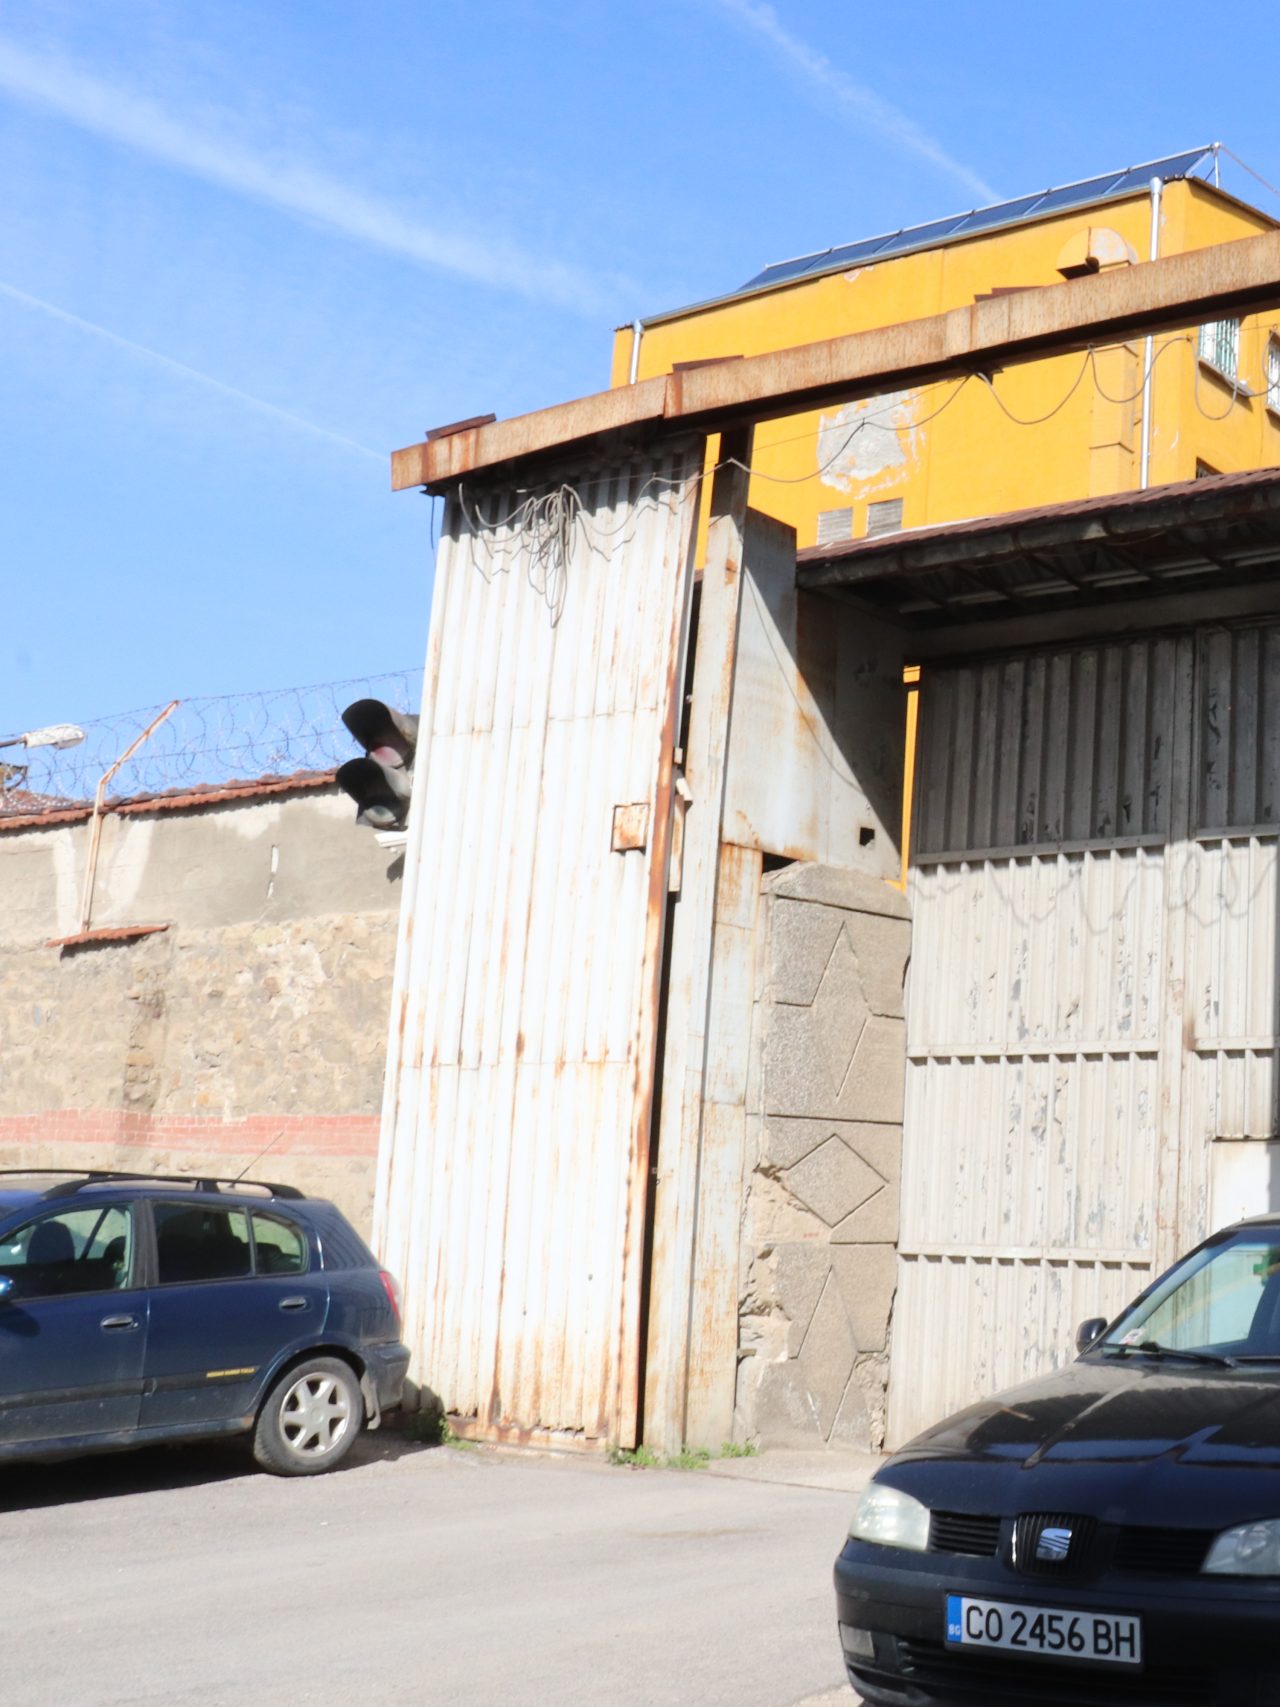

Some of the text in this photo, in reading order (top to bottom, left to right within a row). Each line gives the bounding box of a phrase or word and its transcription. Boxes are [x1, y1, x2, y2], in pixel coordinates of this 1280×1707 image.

[949, 1624, 961, 1636] BG
[966, 1605, 1135, 1658] CO 2456 BH
